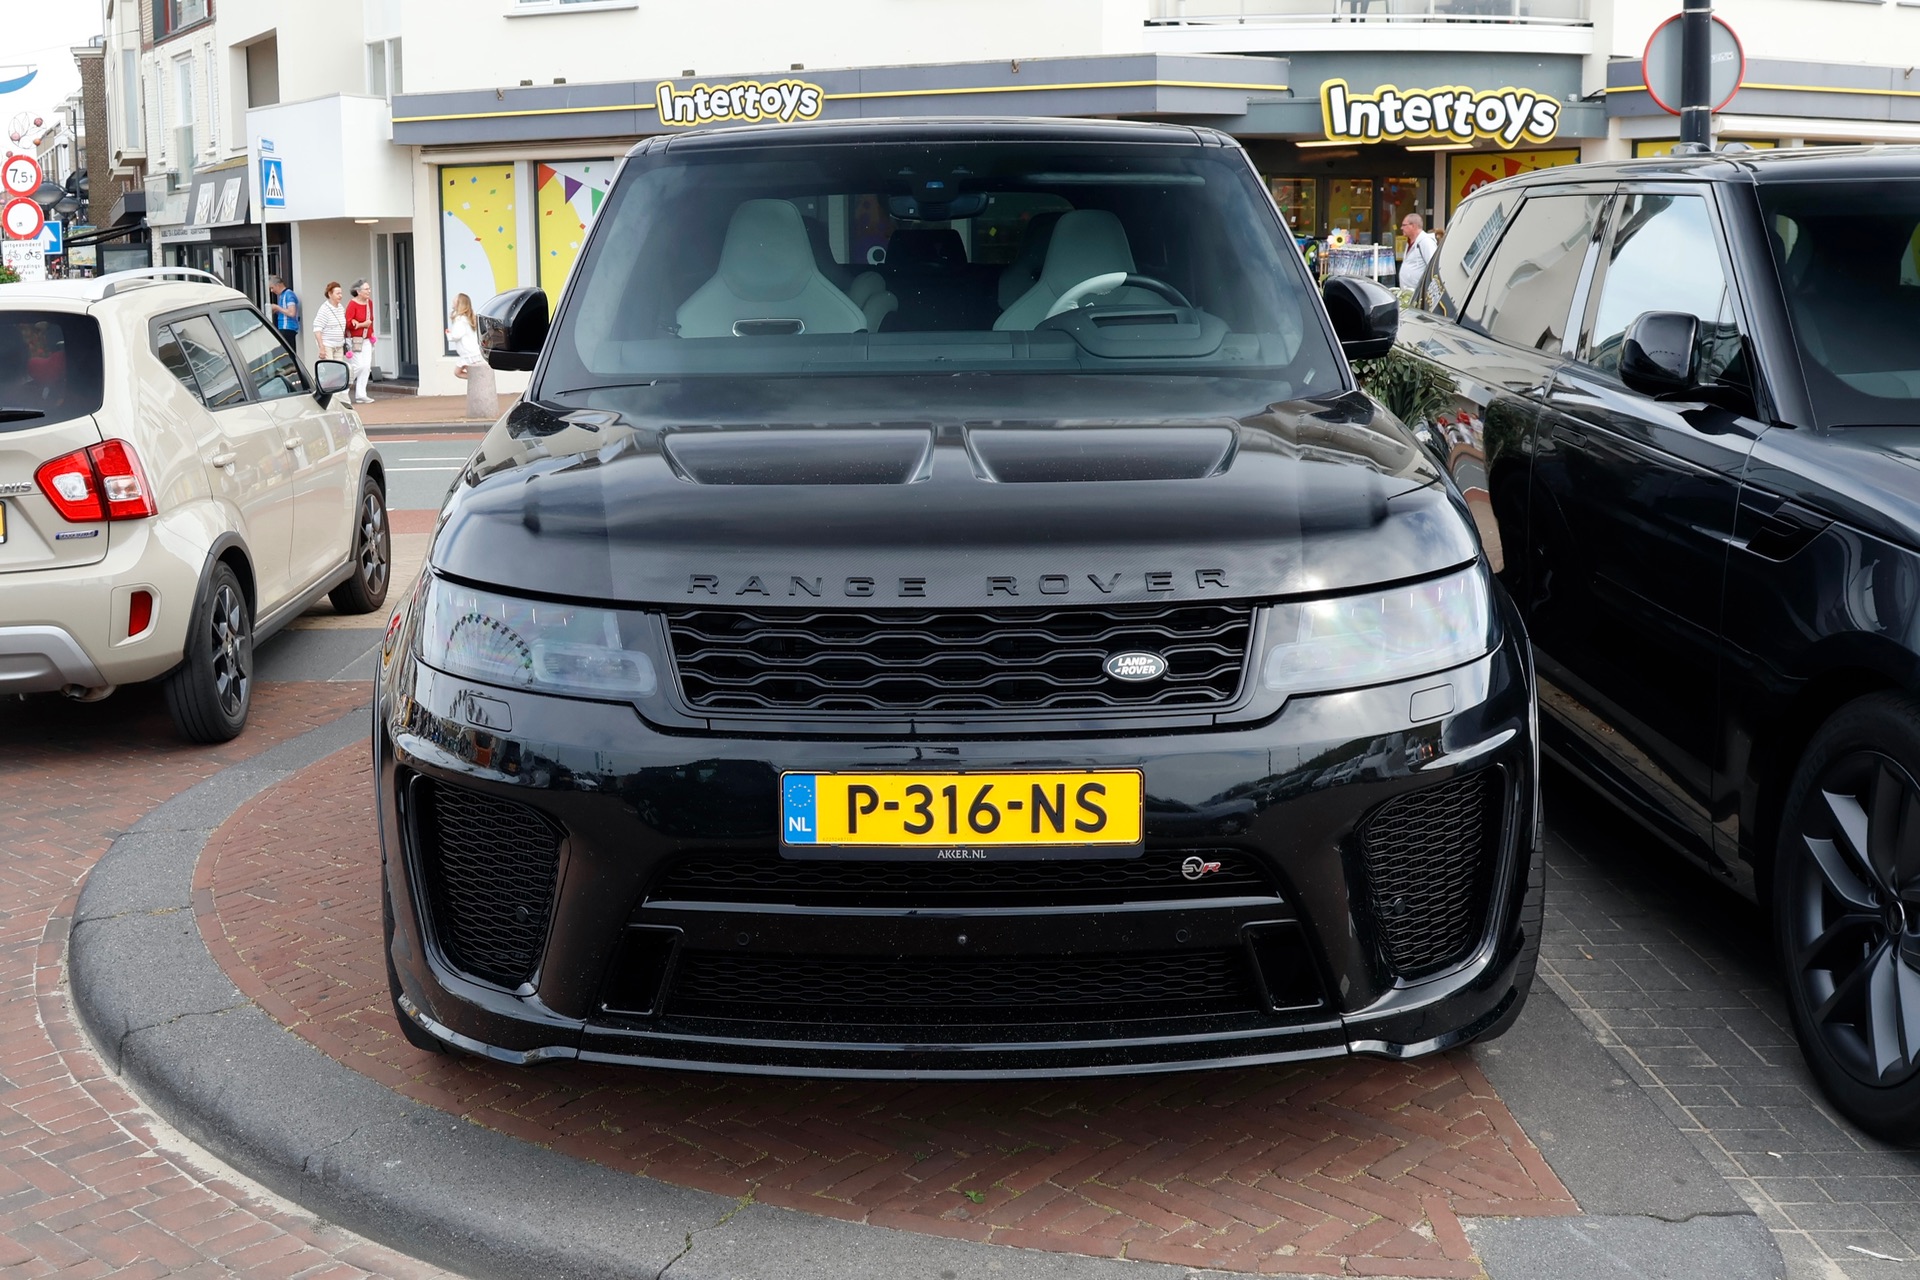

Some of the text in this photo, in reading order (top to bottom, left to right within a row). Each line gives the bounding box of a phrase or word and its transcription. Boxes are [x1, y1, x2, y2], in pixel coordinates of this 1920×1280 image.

[659, 84, 820, 122] Intertoys
[1328, 84, 1560, 143] Intertoys
[687, 568, 1230, 598] RANGE ROVER
[1117, 656, 1147, 667] LAND
[1120, 665, 1157, 676] ROVER
[847, 782, 1108, 835] P-316-NS
[788, 816, 812, 833] NL
[937, 849, 987, 859] AKKER.NL
